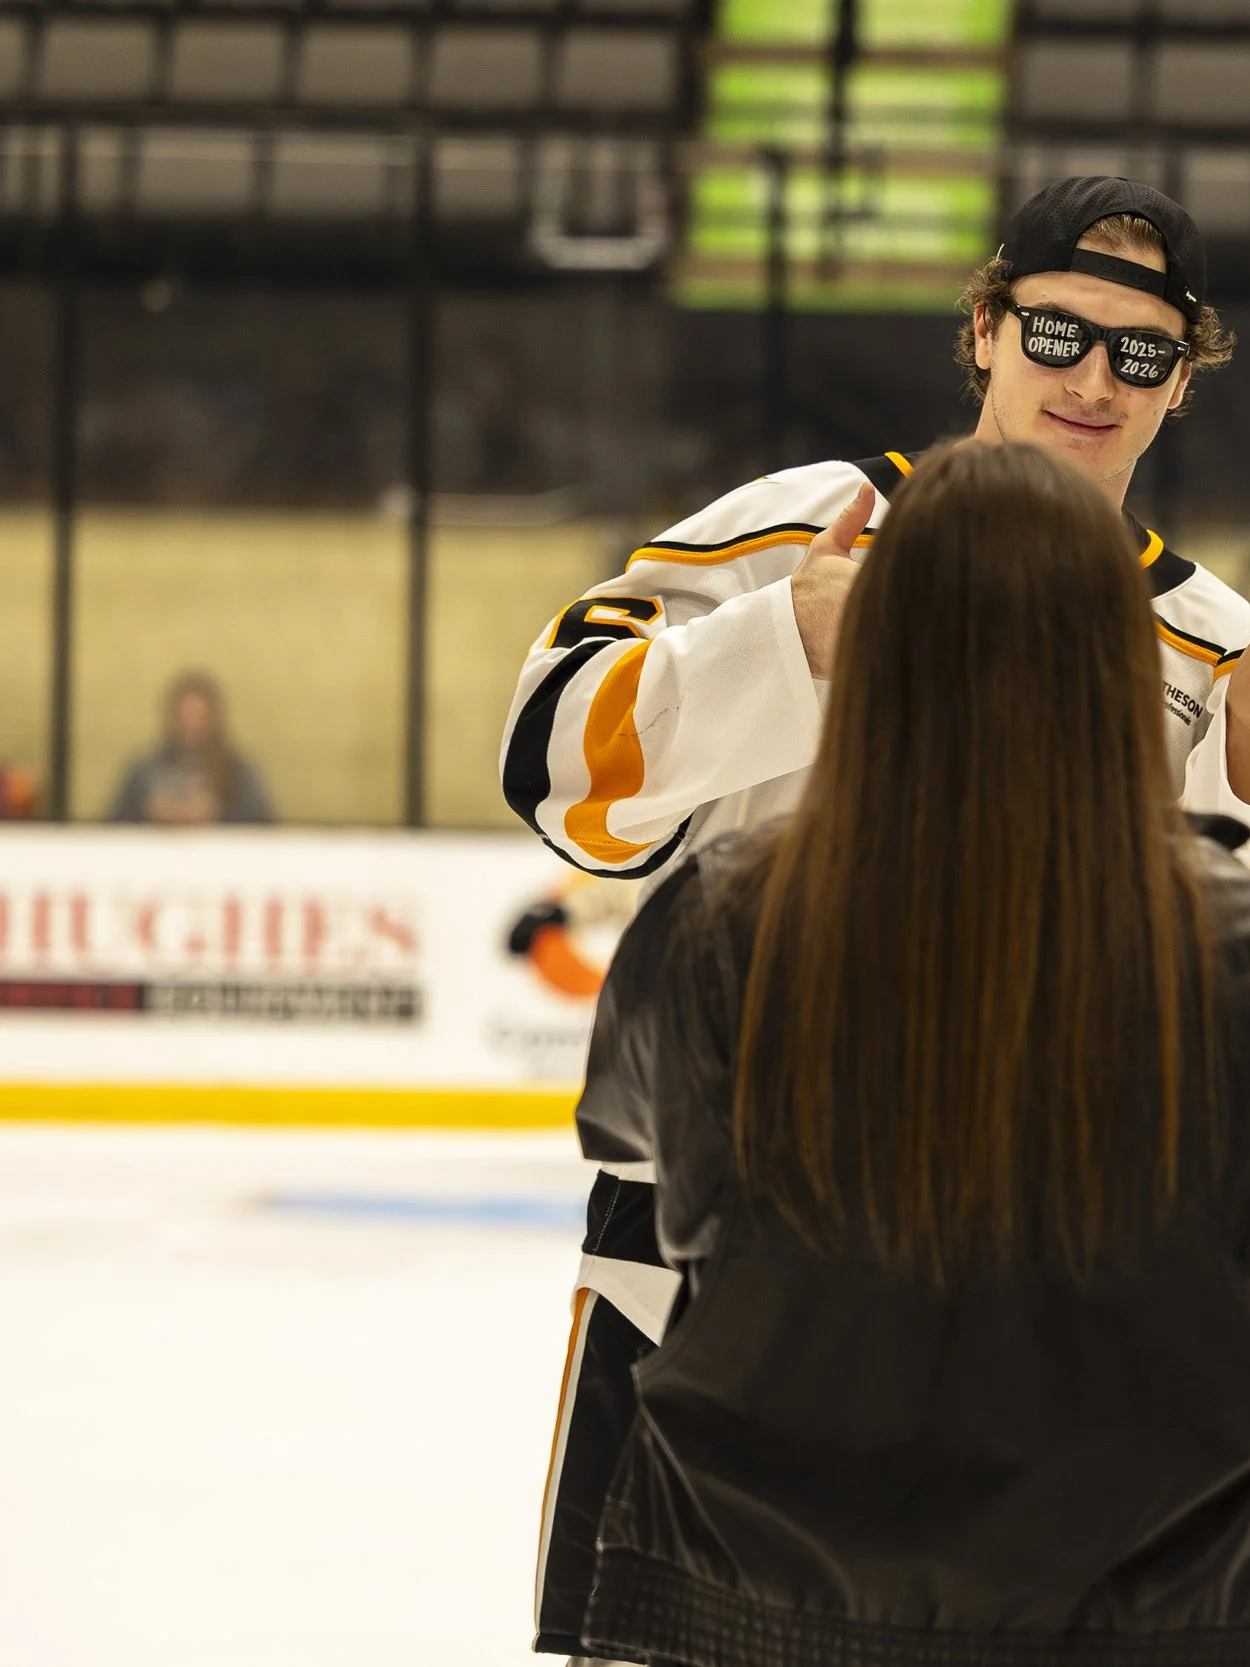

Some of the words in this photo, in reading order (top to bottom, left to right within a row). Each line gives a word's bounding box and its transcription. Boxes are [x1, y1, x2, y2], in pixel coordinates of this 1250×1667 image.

[1031, 316, 1079, 338] HOME
[1028, 336, 1080, 357] OPENER
[1120, 336, 1166, 358] 2025-
[1120, 359, 1159, 379] 2026
